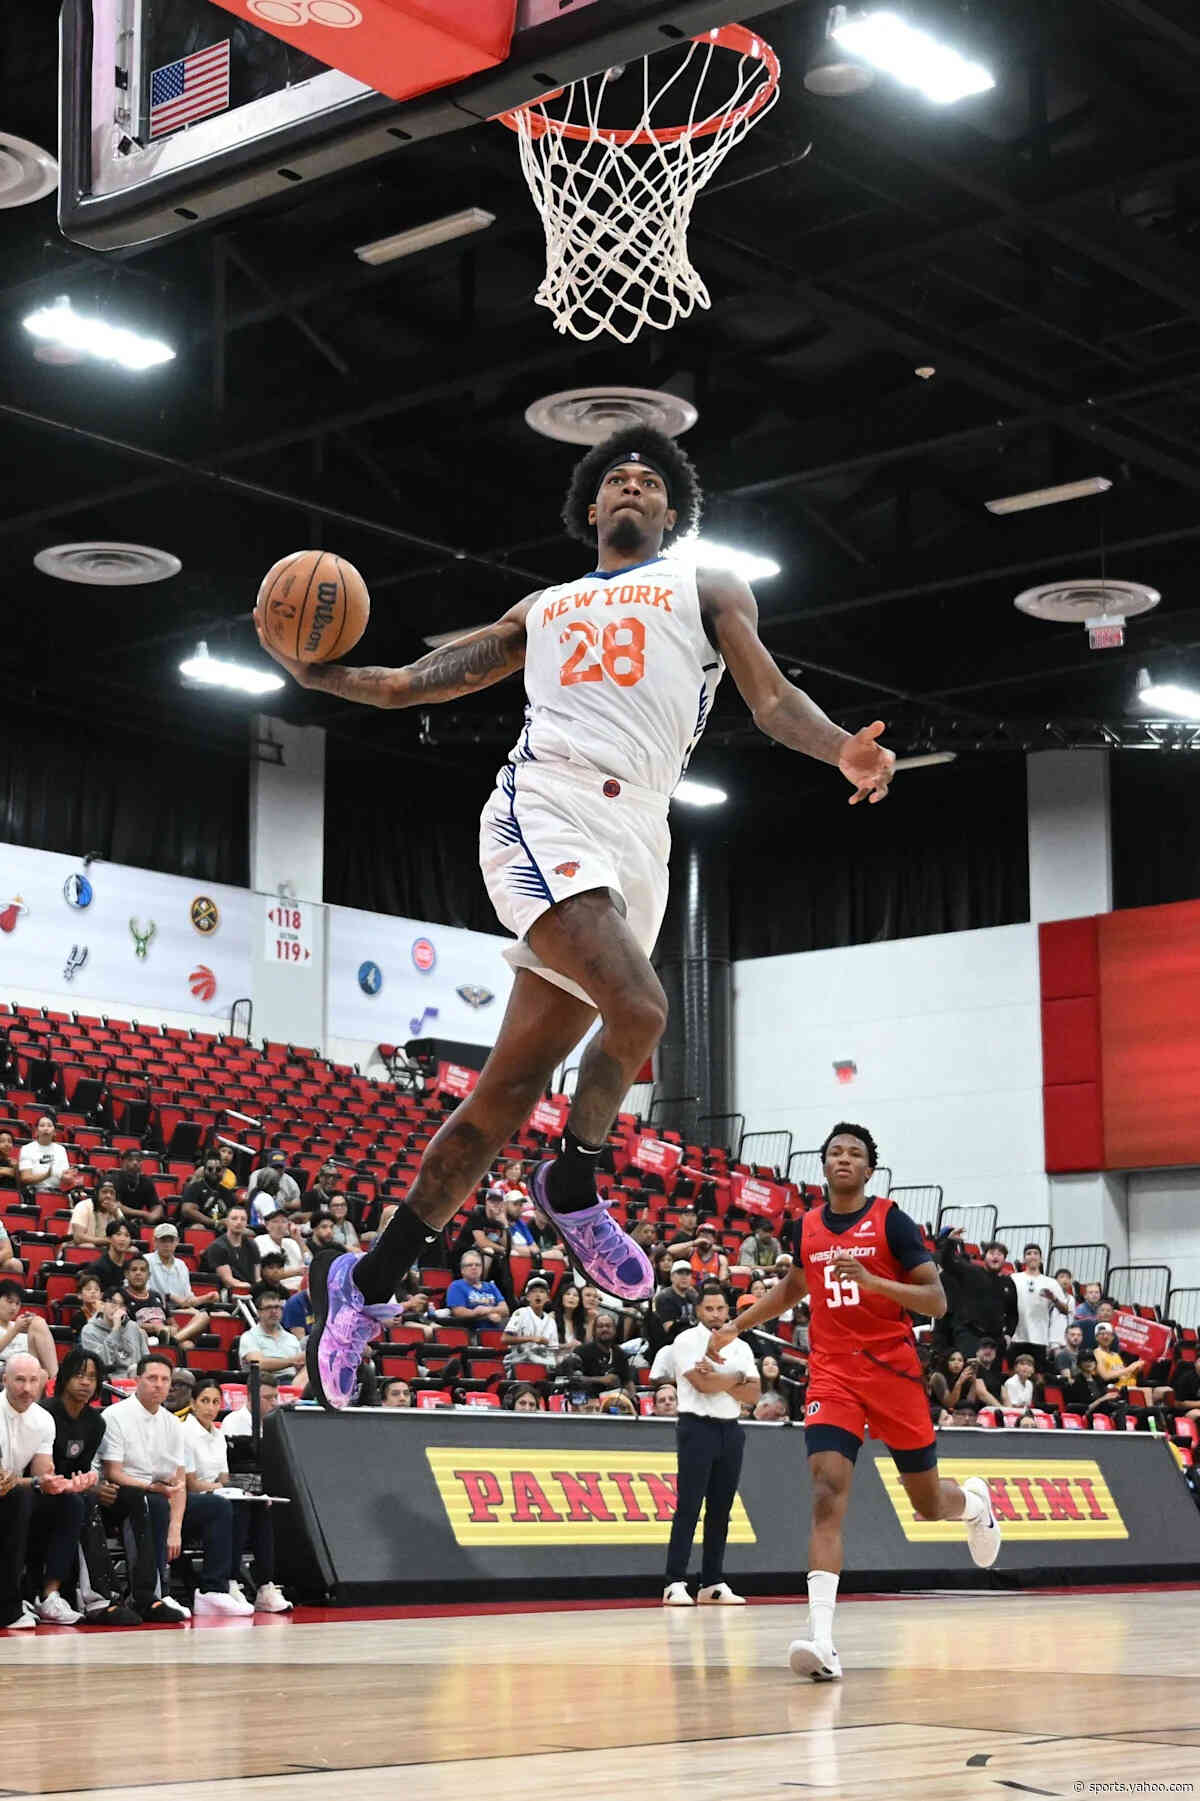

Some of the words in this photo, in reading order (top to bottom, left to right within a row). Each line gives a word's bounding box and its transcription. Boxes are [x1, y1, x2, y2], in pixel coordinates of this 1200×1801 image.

[304, 582, 337, 651] Wilson
[542, 589, 599, 628] NEW
[603, 585, 673, 612] YORK
[560, 617, 646, 687] 28
[277, 907, 301, 929] 118
[276, 940, 300, 961] 119
[824, 1265, 860, 1308] 55
[454, 1470, 703, 1522] PANIN
[897, 1477, 1108, 1522] NINI
